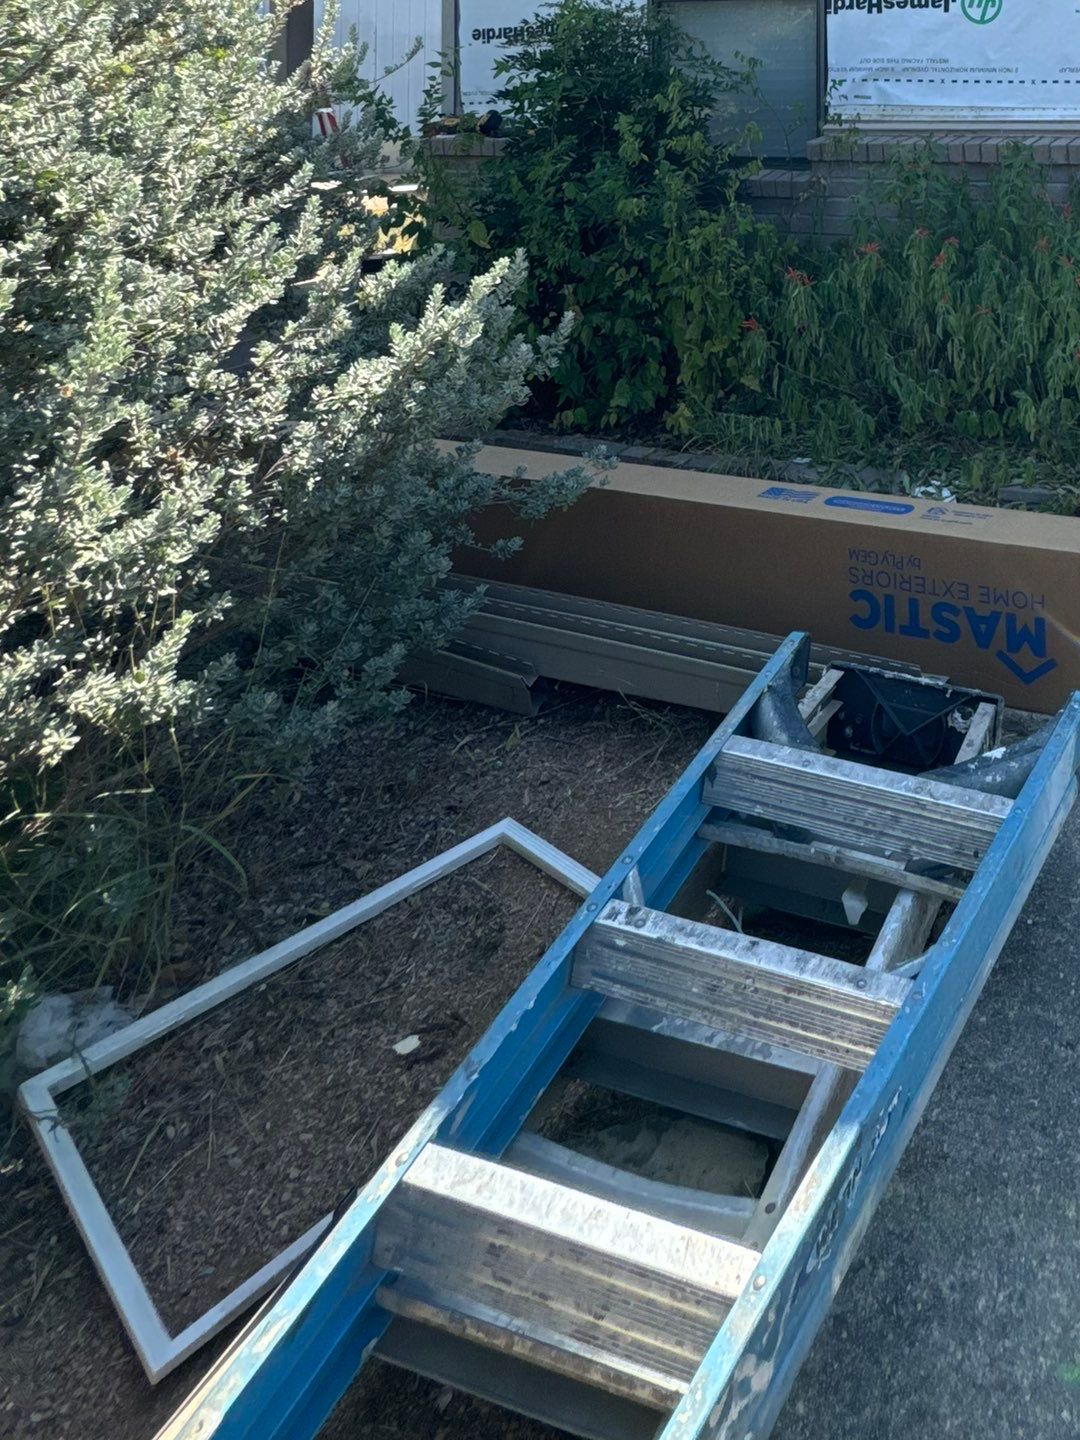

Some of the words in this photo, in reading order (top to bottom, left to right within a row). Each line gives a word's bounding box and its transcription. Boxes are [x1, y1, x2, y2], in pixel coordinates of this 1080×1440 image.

[906, 553, 921, 571] by
[847, 565, 969, 601] EXTERIORS
[972, 584, 1045, 611] HOME
[848, 588, 1047, 659] MASTIC
